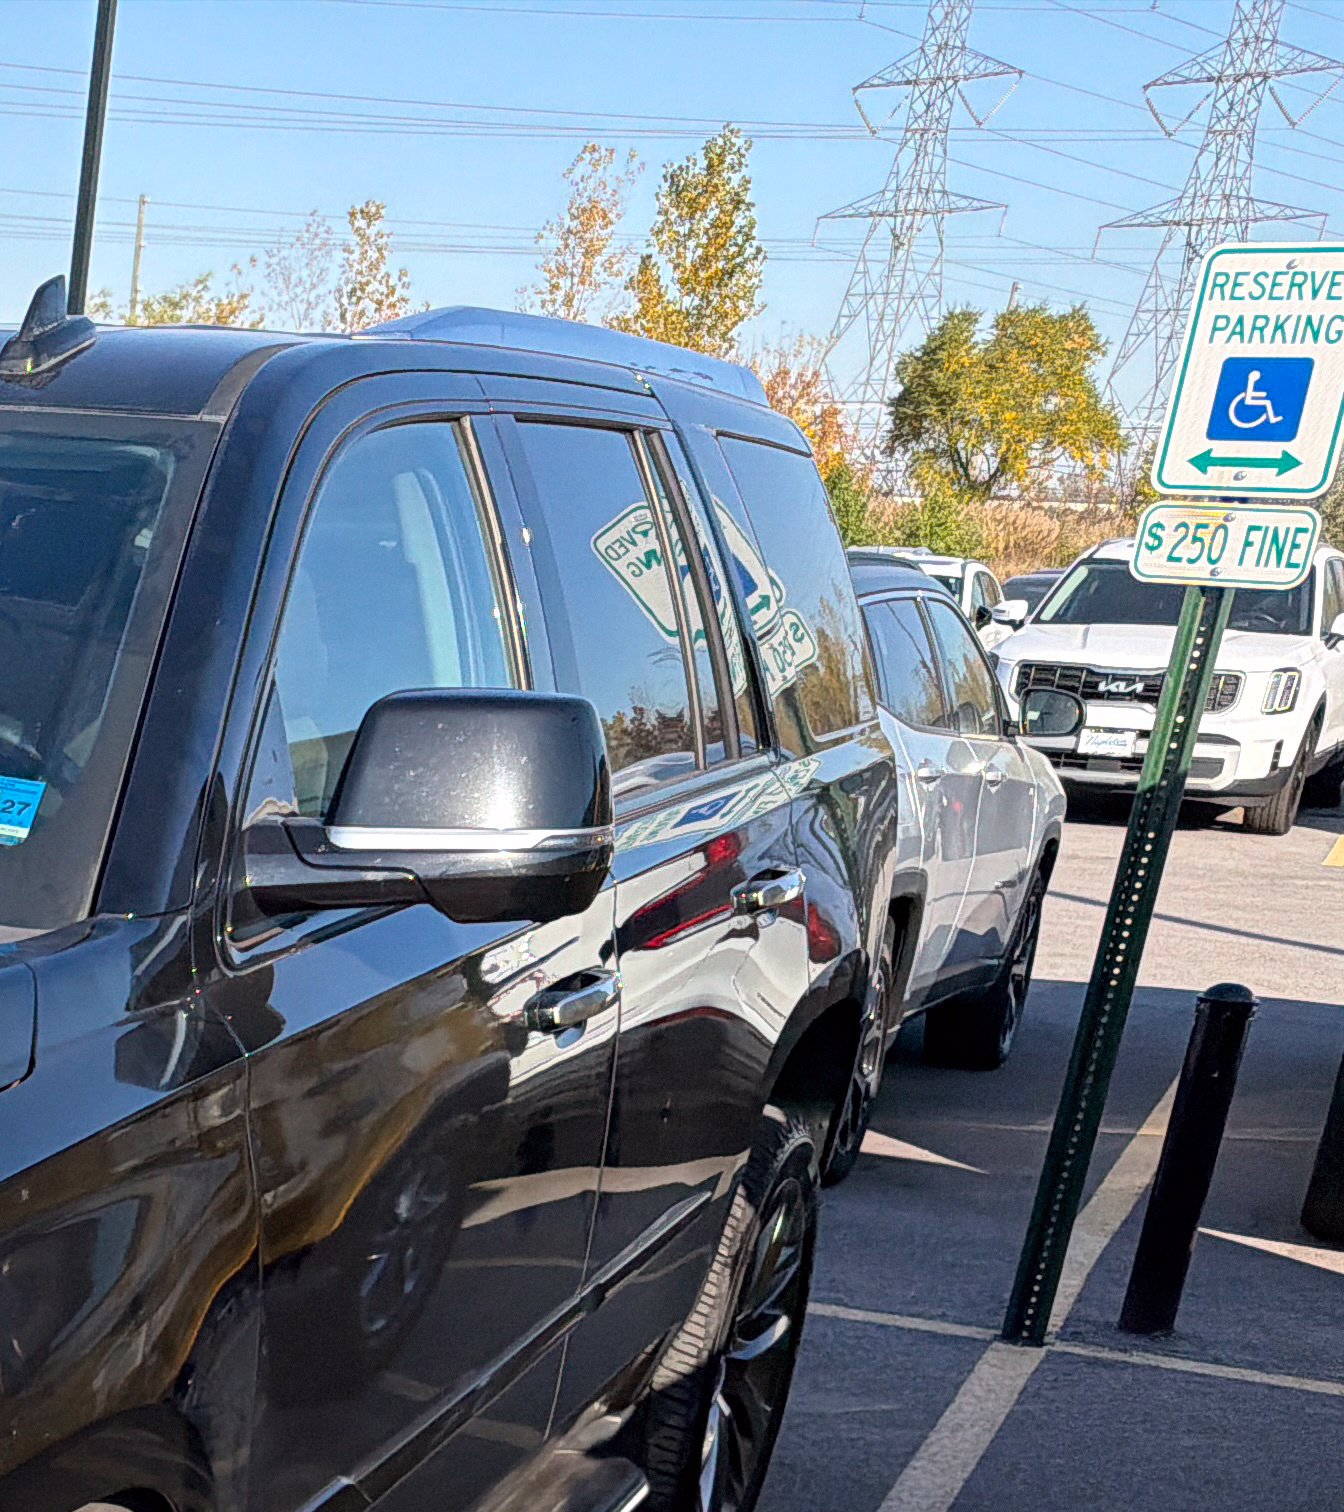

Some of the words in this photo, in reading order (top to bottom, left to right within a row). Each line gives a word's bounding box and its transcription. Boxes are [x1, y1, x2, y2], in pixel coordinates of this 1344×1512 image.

[1208, 270, 1344, 301] RESERVE
[1208, 313, 1344, 345] PARKING
[1237, 524, 1310, 569] FINE
[0, 799, 32, 817] 27
